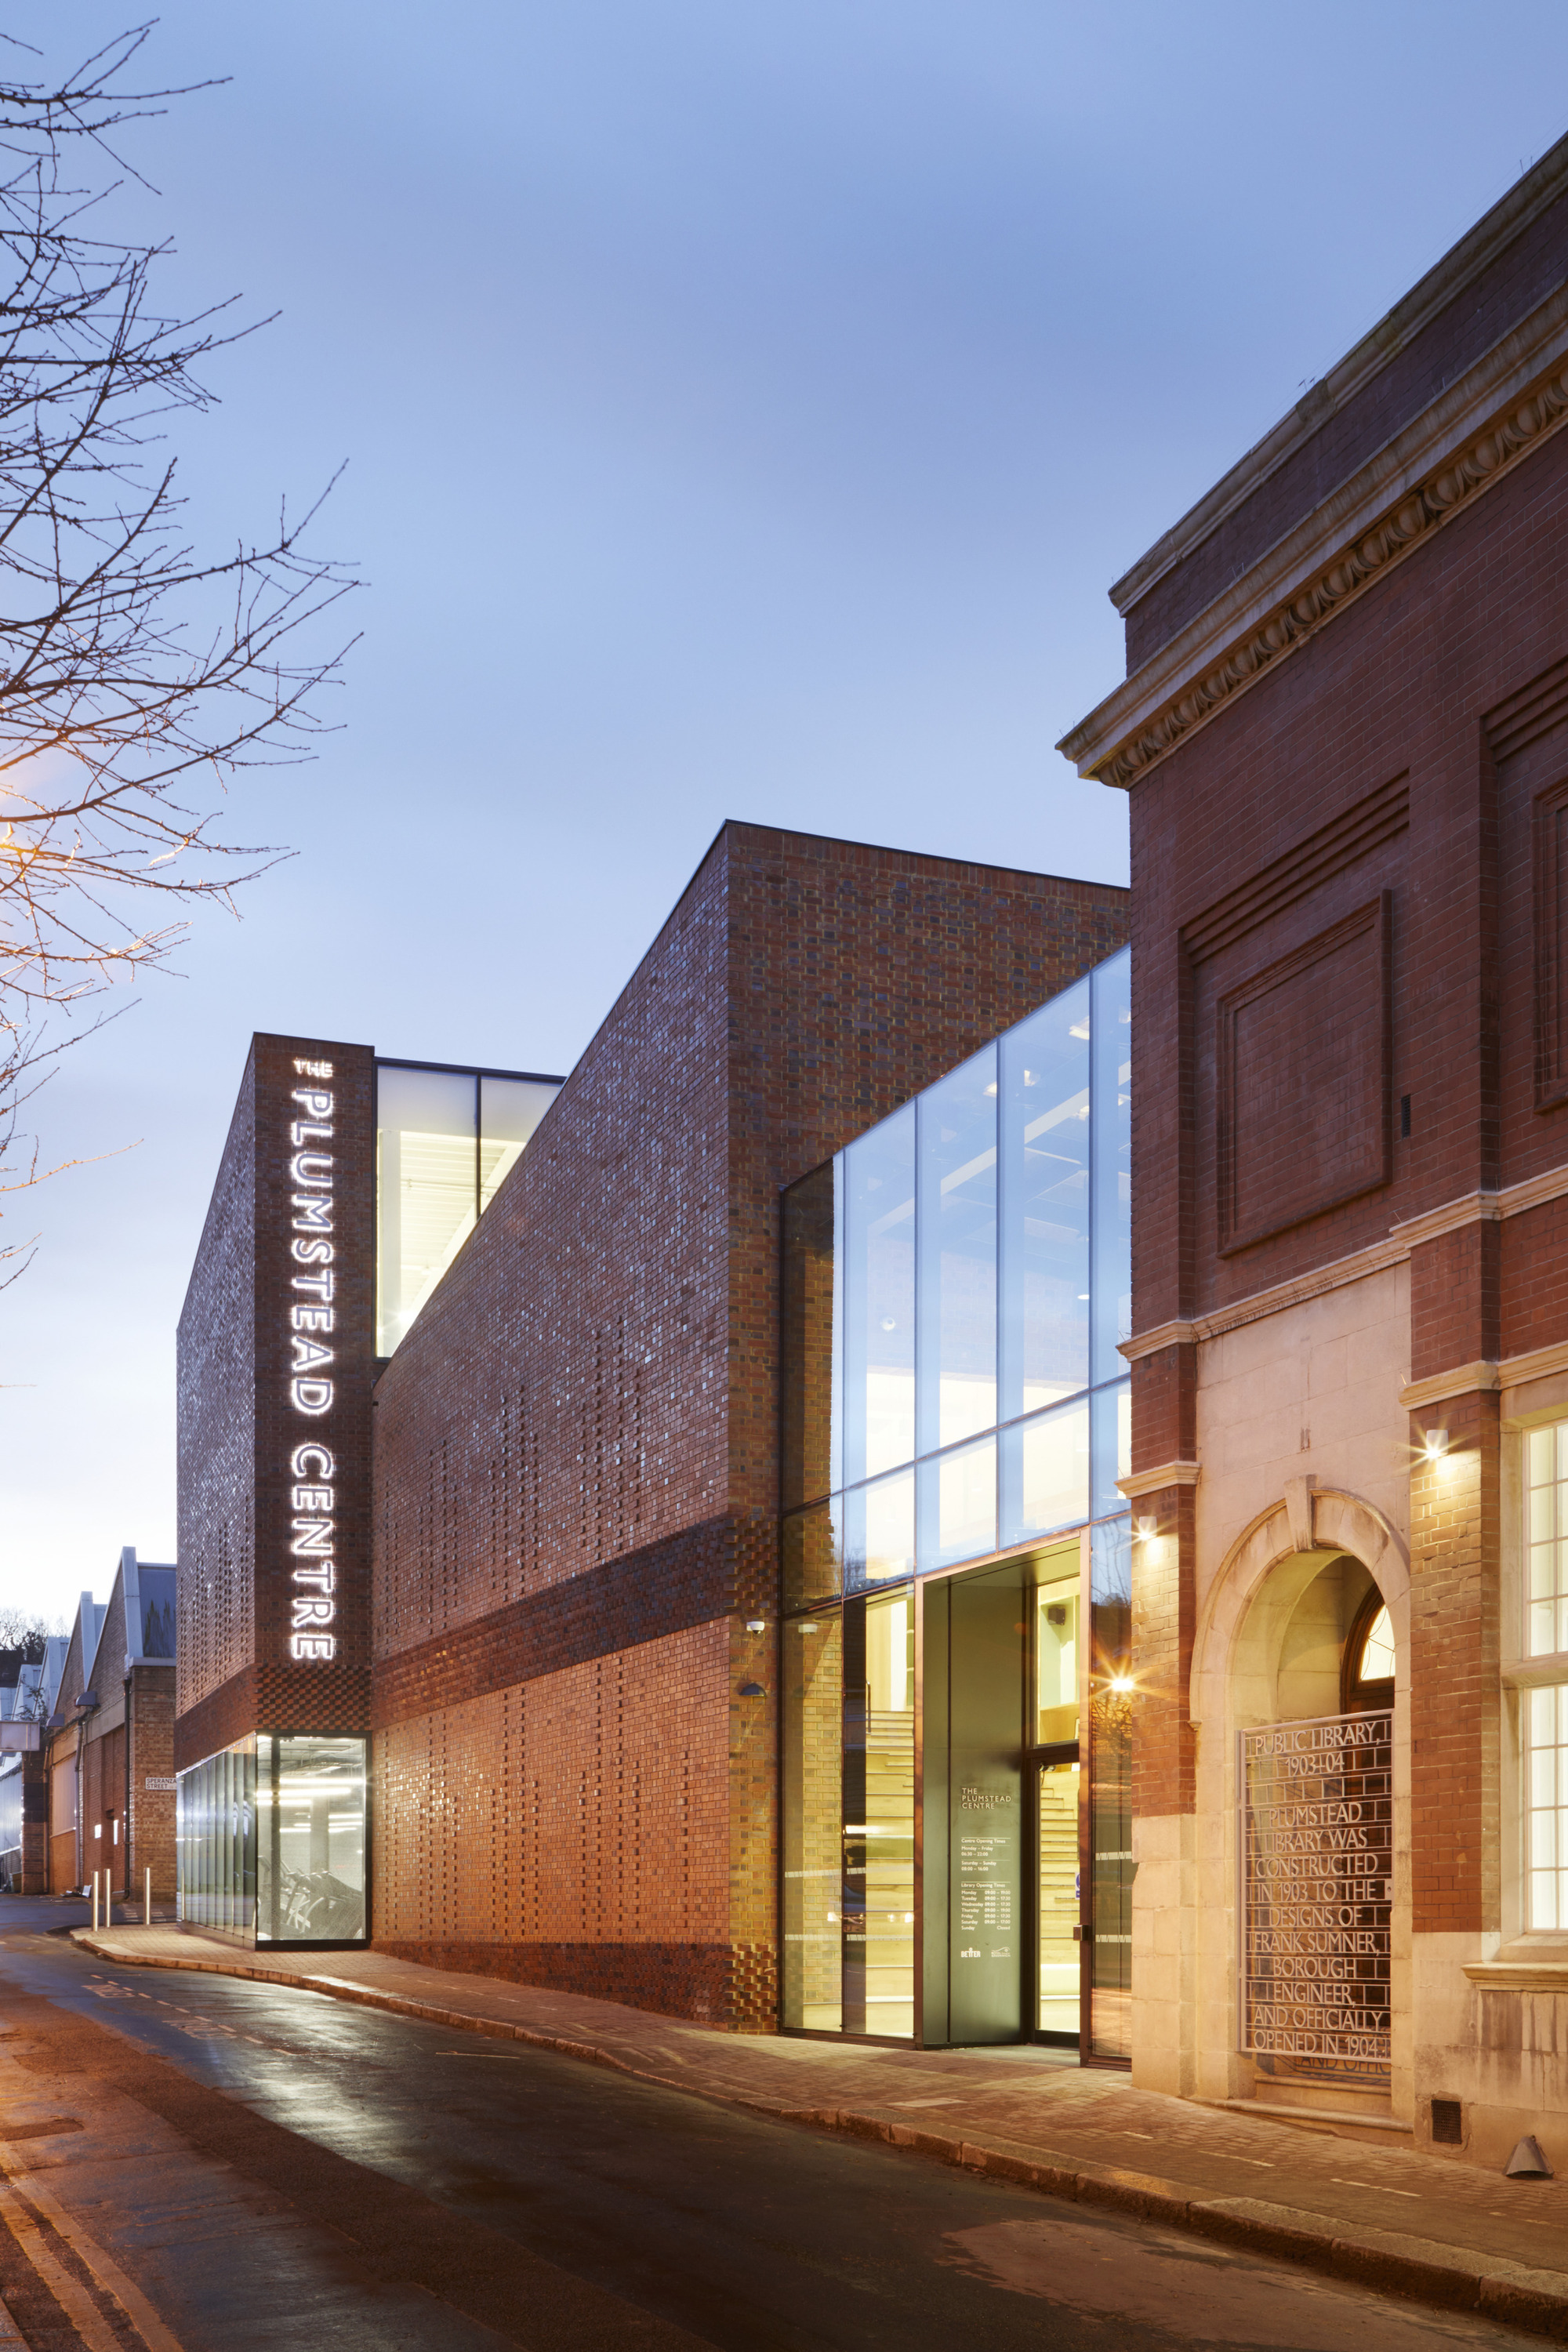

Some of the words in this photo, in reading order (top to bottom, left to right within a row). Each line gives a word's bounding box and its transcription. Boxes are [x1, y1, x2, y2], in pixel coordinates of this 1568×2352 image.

[293, 1059, 332, 1077] THE
[293, 1089, 333, 1412] PLUMSTEAD
[293, 1444, 333, 1659] CENTRE
[1256, 1731, 1307, 1755] PUBLIC
[1312, 1722, 1381, 1750] LIBRARY,
[1269, 1802, 1363, 1828] PLUMSTEAD
[1265, 1830, 1325, 1853] LIBRARY
[1329, 1827, 1368, 1849] WAS
[1256, 1854, 1379, 1878] CONSTRUCTED
[1258, 1883, 1272, 1902] IN
[1278, 1882, 1308, 1902] 1903
[1312, 1881, 1338, 1901] TO
[1341, 1880, 1377, 1900] THE
[1269, 1907, 1334, 1928] DESIGNS
[1338, 1906, 1363, 1927] OF
[1254, 1932, 1305, 1952] FRANK
[1307, 1932, 1380, 1956] SUMNER,
[1273, 1958, 1357, 1979] BOROUGH
[1273, 1982, 1356, 2008] ENGINEER,
[1254, 2005, 1289, 2027] AND
[1293, 2007, 1383, 2032] OFFICIALLY
[1254, 2030, 1317, 2054] OPENED
[1322, 2034, 1339, 2056] IN
